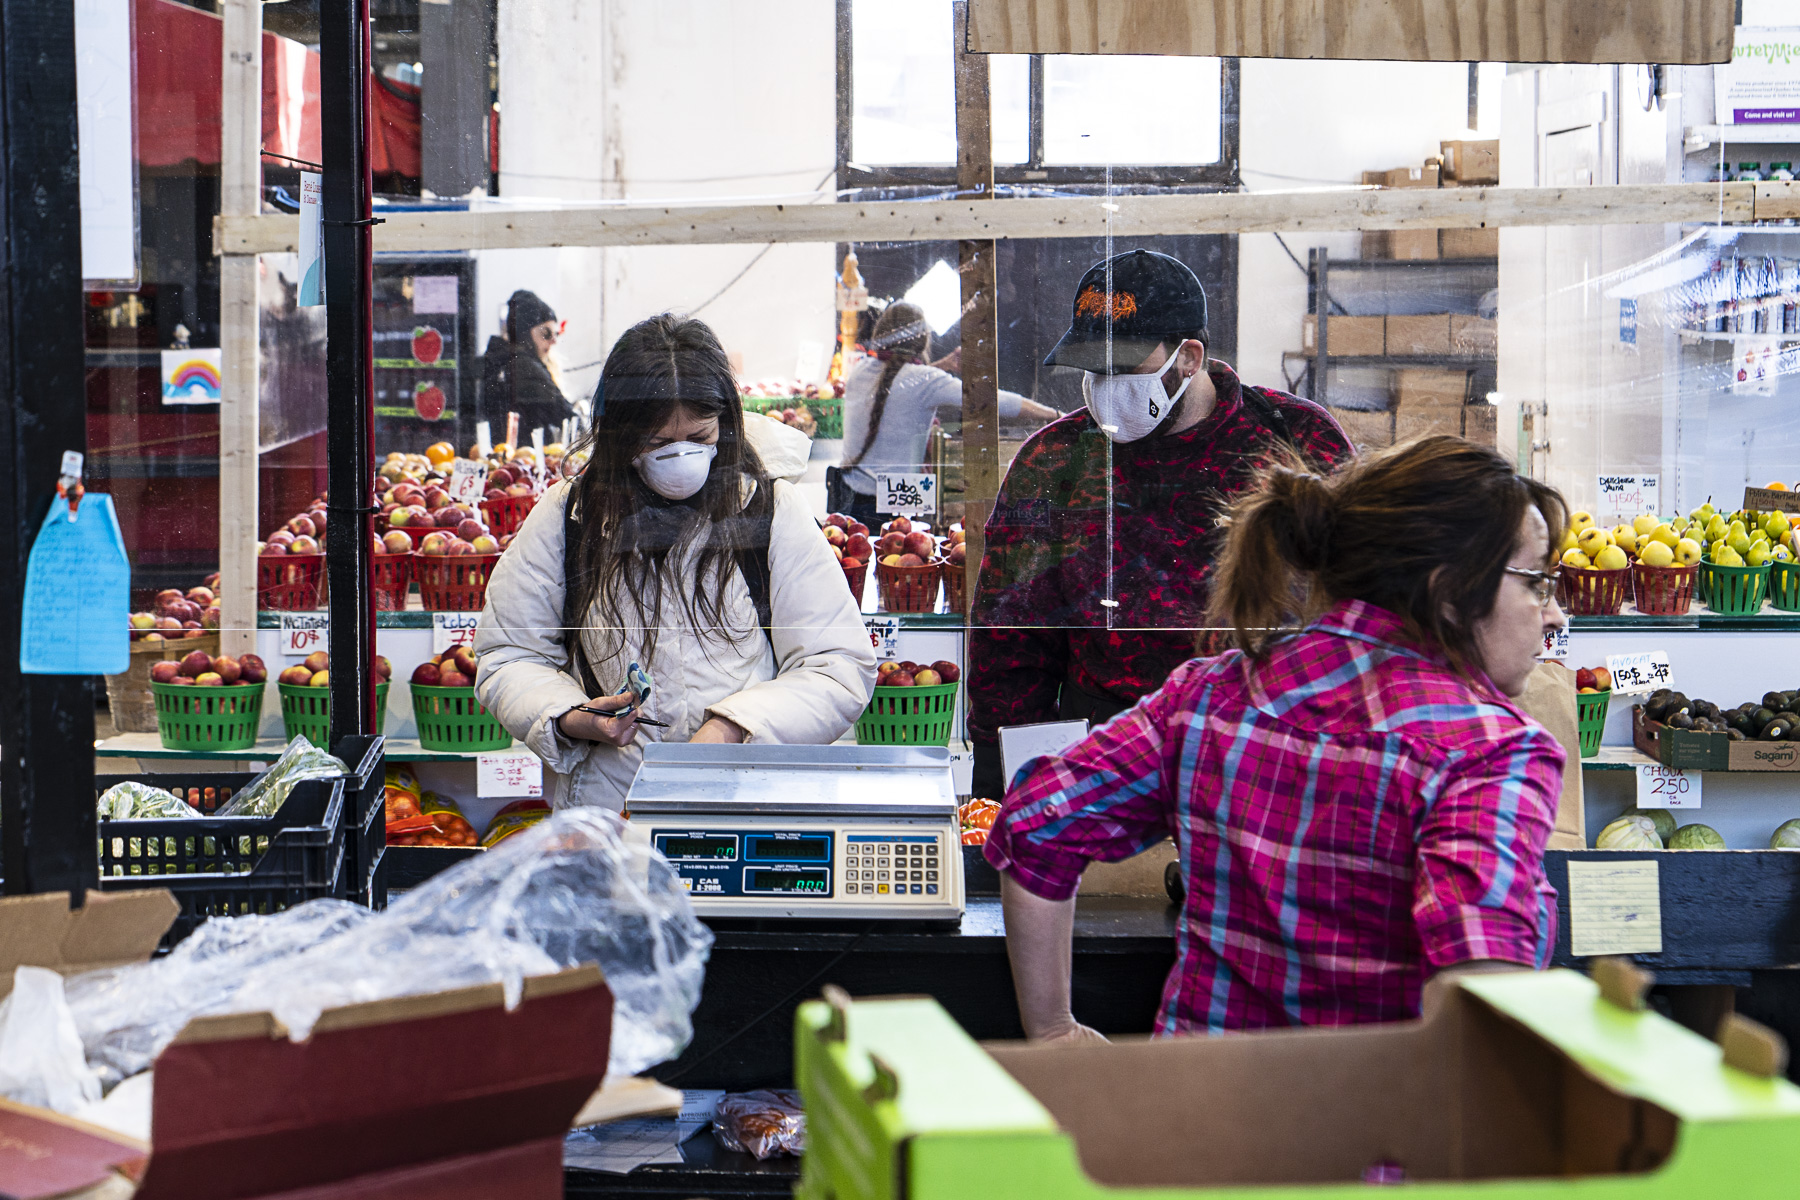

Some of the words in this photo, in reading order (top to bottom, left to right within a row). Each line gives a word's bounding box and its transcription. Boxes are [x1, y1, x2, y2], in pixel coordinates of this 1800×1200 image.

[887, 478, 917, 493] Lobo
[291, 630, 320, 649] 10$
[1612, 654, 1650, 668] AVOCAT
[1754, 750, 1793, 762] Sagami
[1643, 766, 1684, 777] CHOUX
[1651, 778, 1689, 795] 2.50
